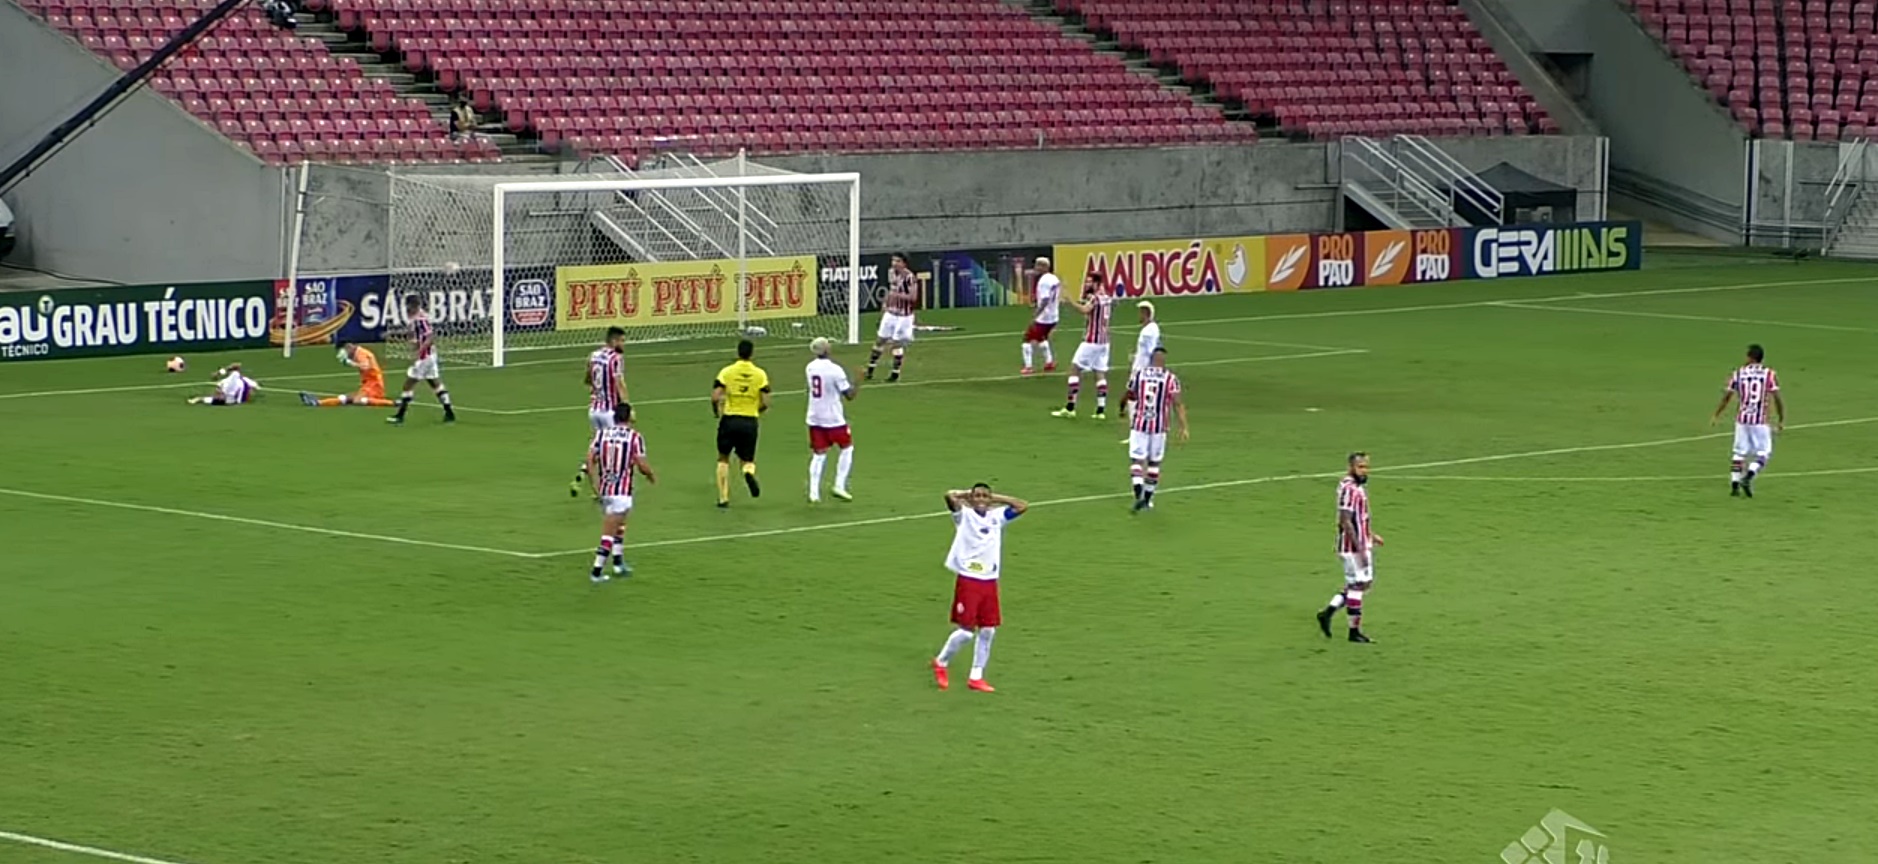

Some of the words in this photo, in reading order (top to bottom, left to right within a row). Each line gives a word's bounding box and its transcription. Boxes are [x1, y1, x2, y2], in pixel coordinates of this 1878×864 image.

[1319, 232, 1354, 260] PRO
[1415, 229, 1450, 255] PRO
[1081, 239, 1222, 301] MAURICÉA
[515, 295, 546, 308] BRAZ
[53, 303, 138, 347] GRAU
[144, 287, 267, 342] TÉCNICO
[811, 375, 822, 399] 9
[1741, 379, 1761, 403] 19
